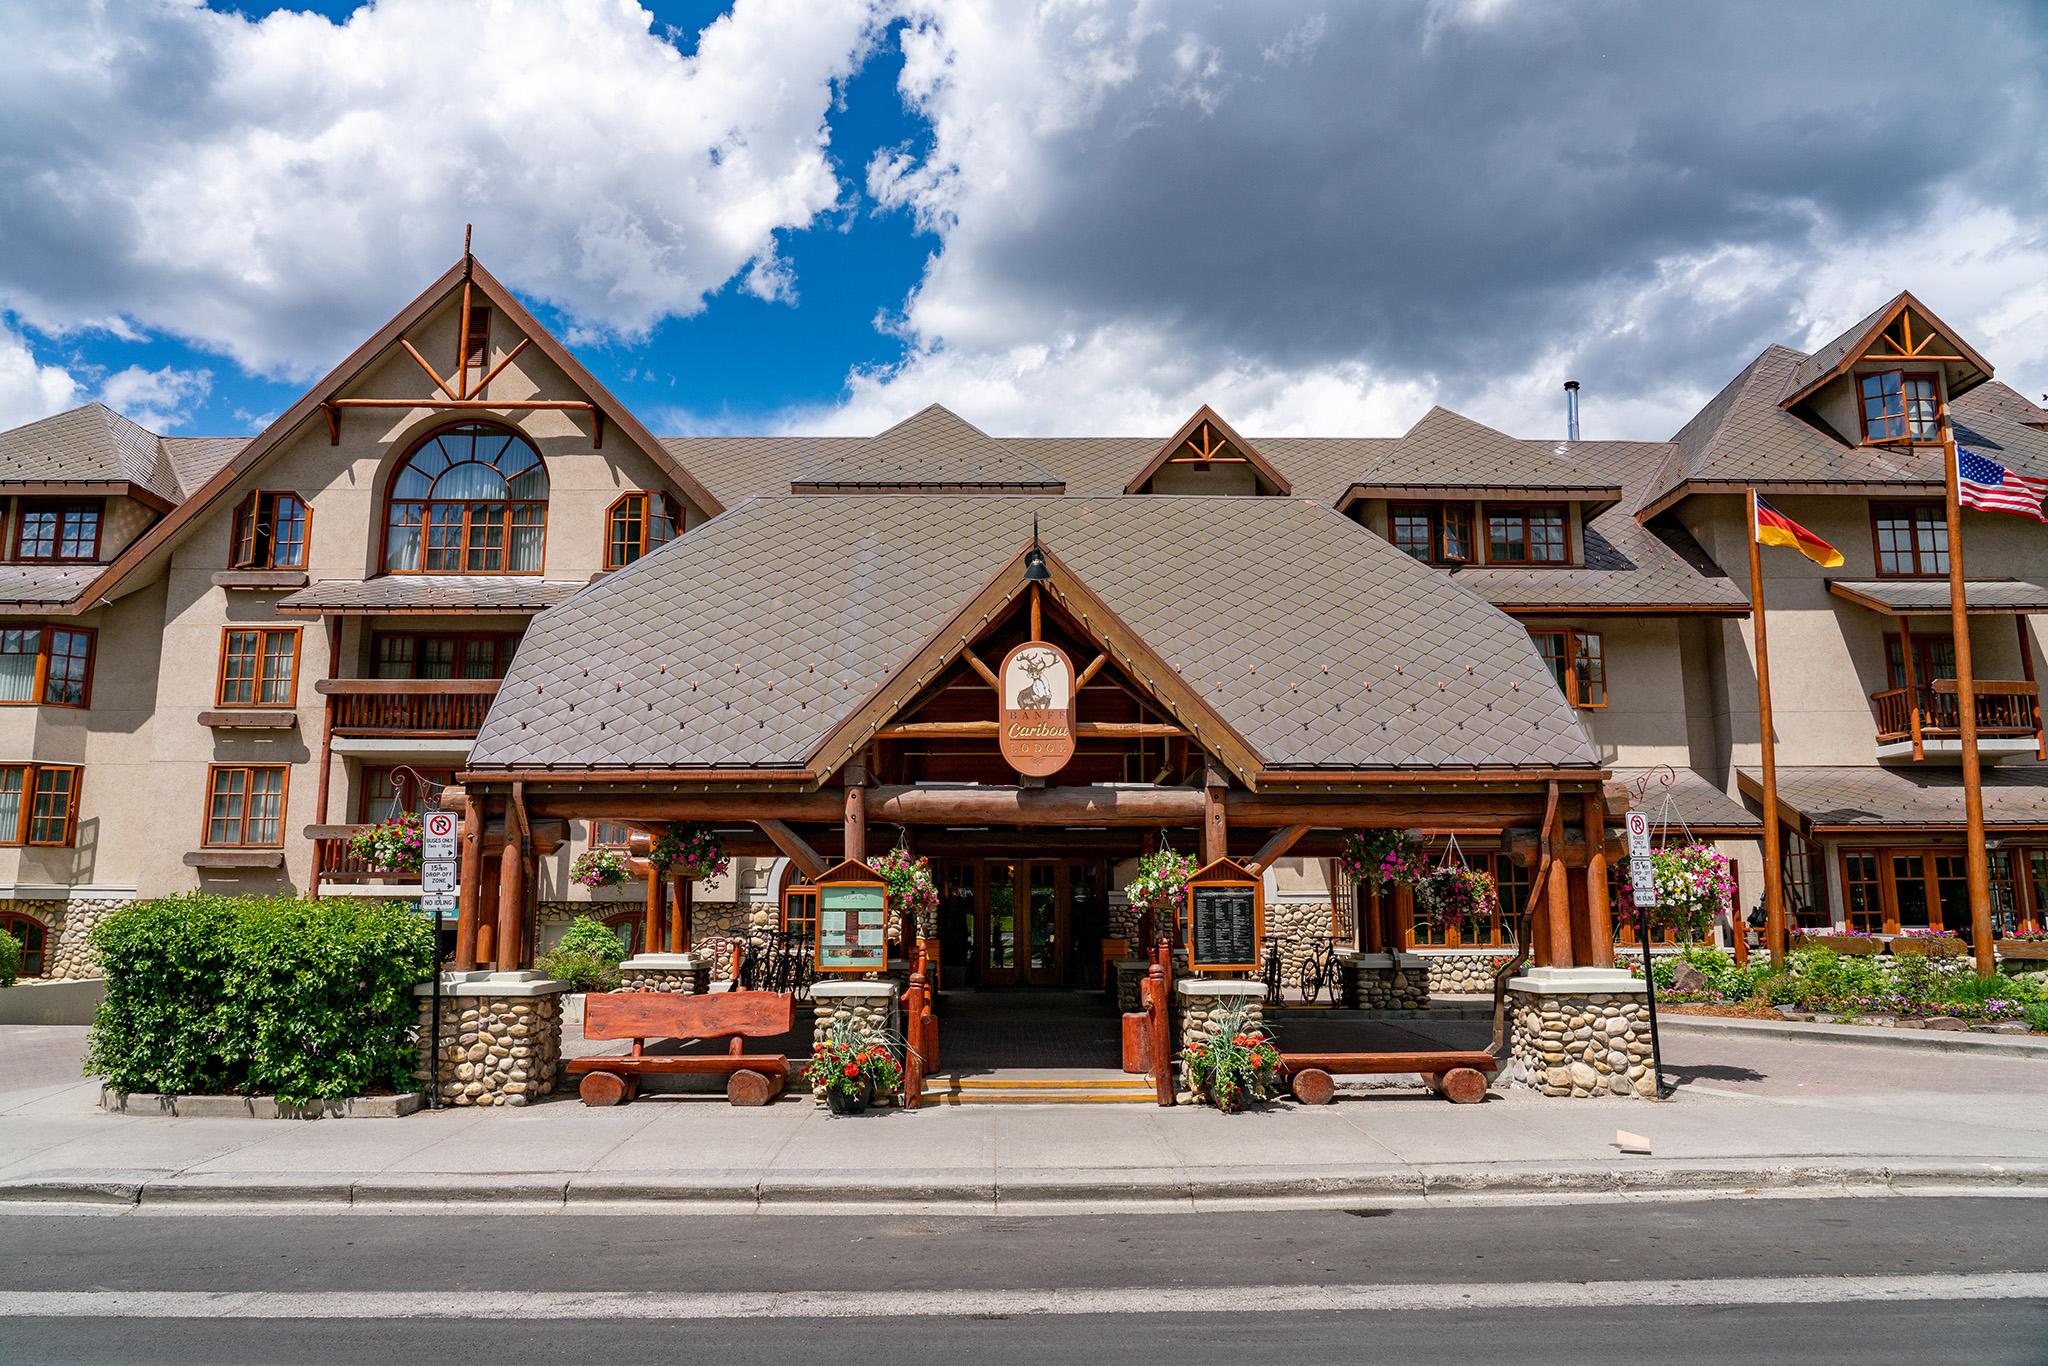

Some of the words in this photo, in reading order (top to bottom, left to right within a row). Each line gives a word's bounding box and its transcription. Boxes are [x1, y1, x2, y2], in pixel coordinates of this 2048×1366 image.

[1010, 711, 1065, 720] BANFF
[1008, 722, 1069, 739] Caribou
[1010, 743, 1066, 753] LODGE
